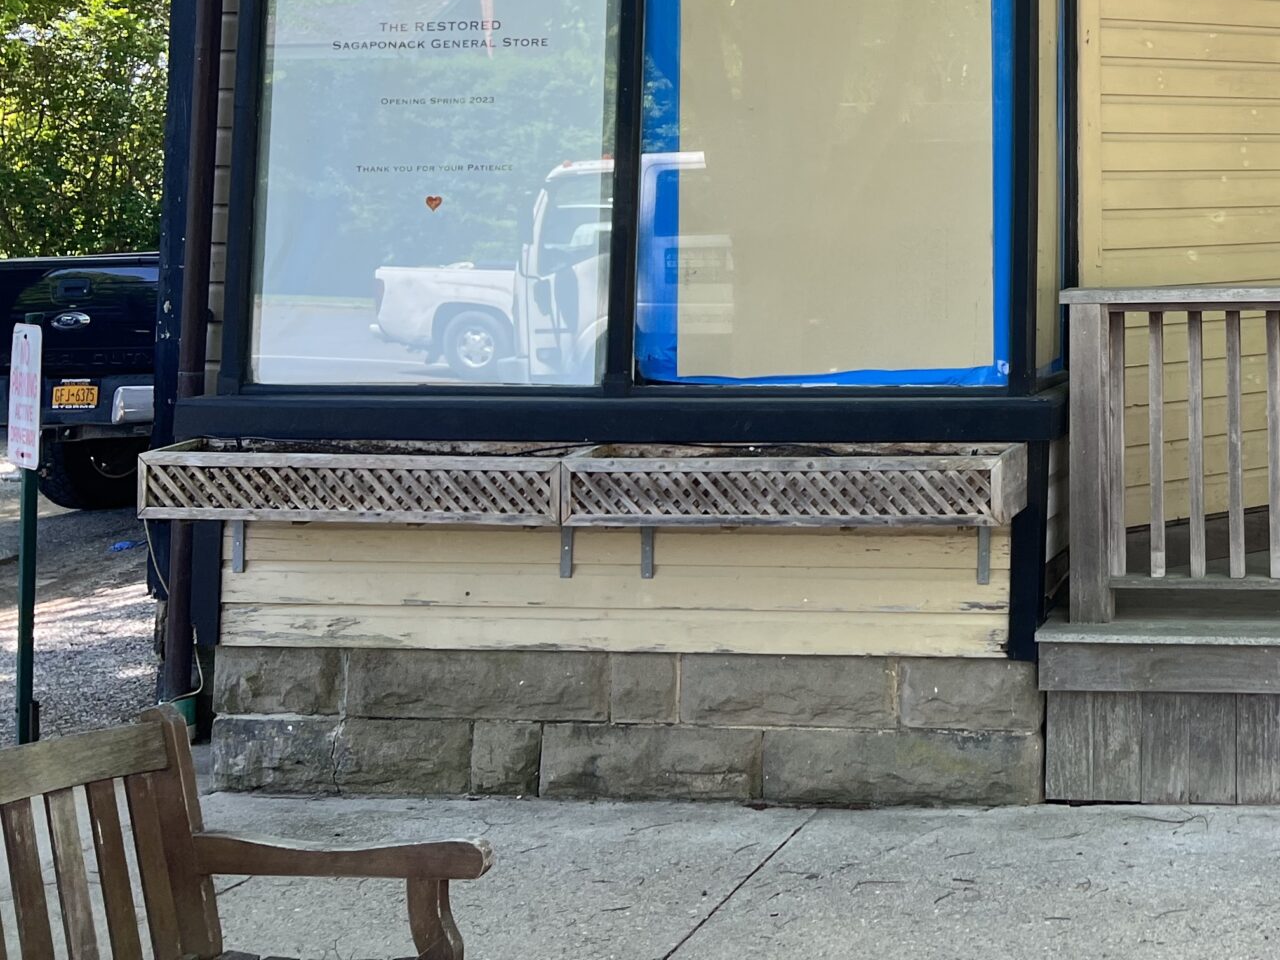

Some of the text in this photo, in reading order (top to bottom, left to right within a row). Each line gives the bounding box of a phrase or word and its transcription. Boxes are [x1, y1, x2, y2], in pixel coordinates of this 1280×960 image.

[379, 20, 502, 32] THE RESTORED
[332, 37, 548, 50] SAGAPONACK GENERAL STORE
[380, 96, 495, 105] OPENING SPRING 2023
[356, 165, 390, 173] THANK
[438, 164, 464, 172] YOUR
[467, 163, 513, 171] PATIENCE
